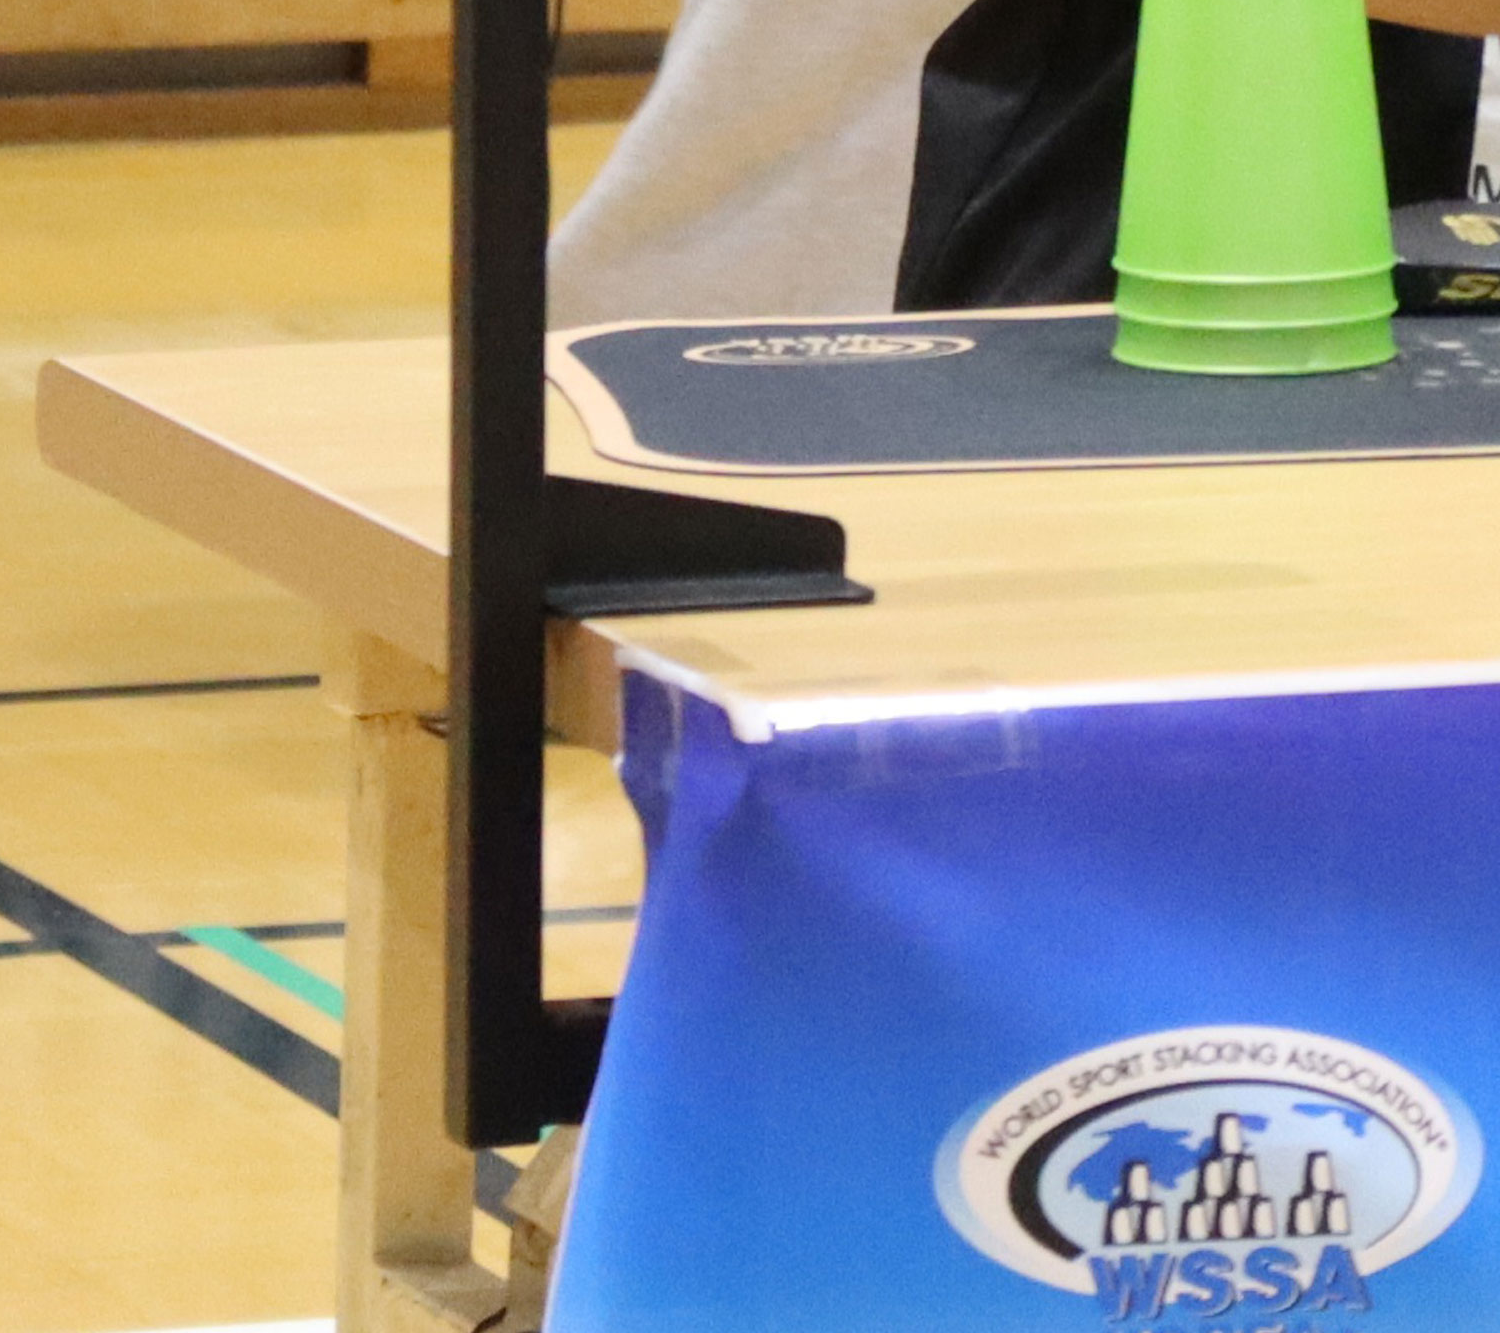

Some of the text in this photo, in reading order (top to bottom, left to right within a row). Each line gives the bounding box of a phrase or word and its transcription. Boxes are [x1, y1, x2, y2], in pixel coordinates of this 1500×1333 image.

[978, 1040, 1442, 1160] WORLD SPORT STACKING ASSOCIATION
[1087, 1244, 1374, 1323] WSSA
